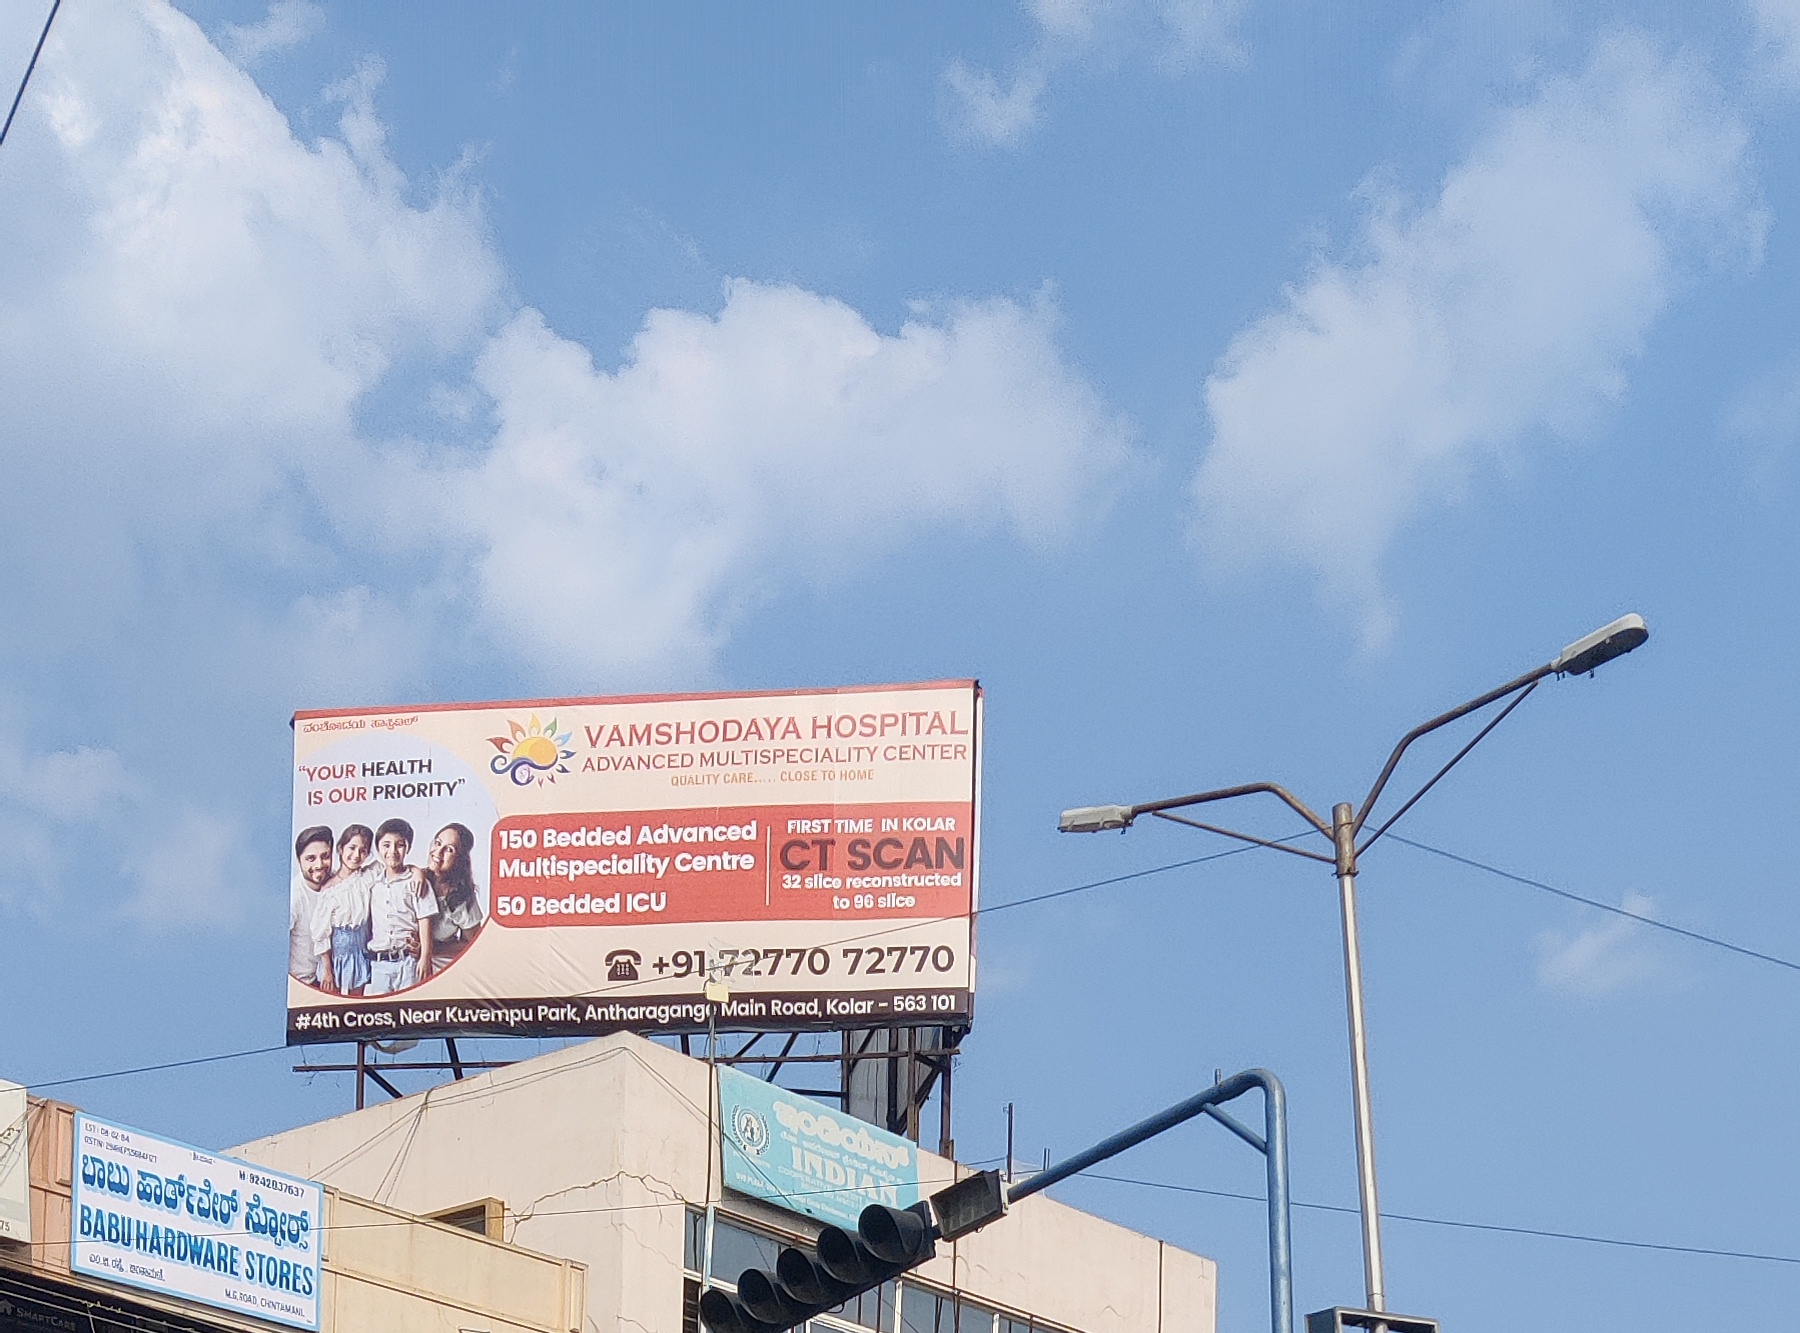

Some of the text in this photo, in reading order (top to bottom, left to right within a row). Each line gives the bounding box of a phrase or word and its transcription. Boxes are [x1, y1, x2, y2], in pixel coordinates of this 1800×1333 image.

[584, 710, 969, 749] VAMSHODAYA HOSPITAL
[361, 758, 433, 778] HEALTH
[582, 743, 967, 773] ADVANCED MULTISPECIALITY CENTER
[671, 773, 720, 787] QUALITY
[780, 770, 818, 782] CLOSE
[821, 769, 836, 781] TO
[839, 768, 874, 781] HOME
[308, 790, 322, 806] IS
[328, 787, 367, 805] OUR
[499, 821, 757, 850] 150 Bedded Advanced
[787, 817, 956, 834] FIRST TIME IN KOLAR
[499, 852, 755, 882] Multispeciality Centre
[779, 836, 965, 871] CT SCAN
[782, 871, 962, 889] 32 slice reconstructed
[497, 892, 667, 917] 50 Bedded ICU
[833, 893, 915, 909] to 96 slice
[652, 945, 955, 979] +91 72770 72770
[295, 1010, 340, 1029] #4th
[343, 1010, 397, 1028] Cross,
[400, 1007, 442, 1026] Near
[445, 1005, 533, 1027] Kuvempu
[538, 1004, 581, 1024] Park,
[721, 999, 768, 1018] Main
[771, 998, 822, 1018] Road,
[827, 997, 875, 1016] Kolar
[893, 995, 927, 1012] 563
[930, 994, 956, 1011] 101
[81, 1154, 131, 1197] ಬಾಬು
[791, 1145, 898, 1206] INDIAN
[80, 1204, 314, 1297] BABU HARDWARE STORES
